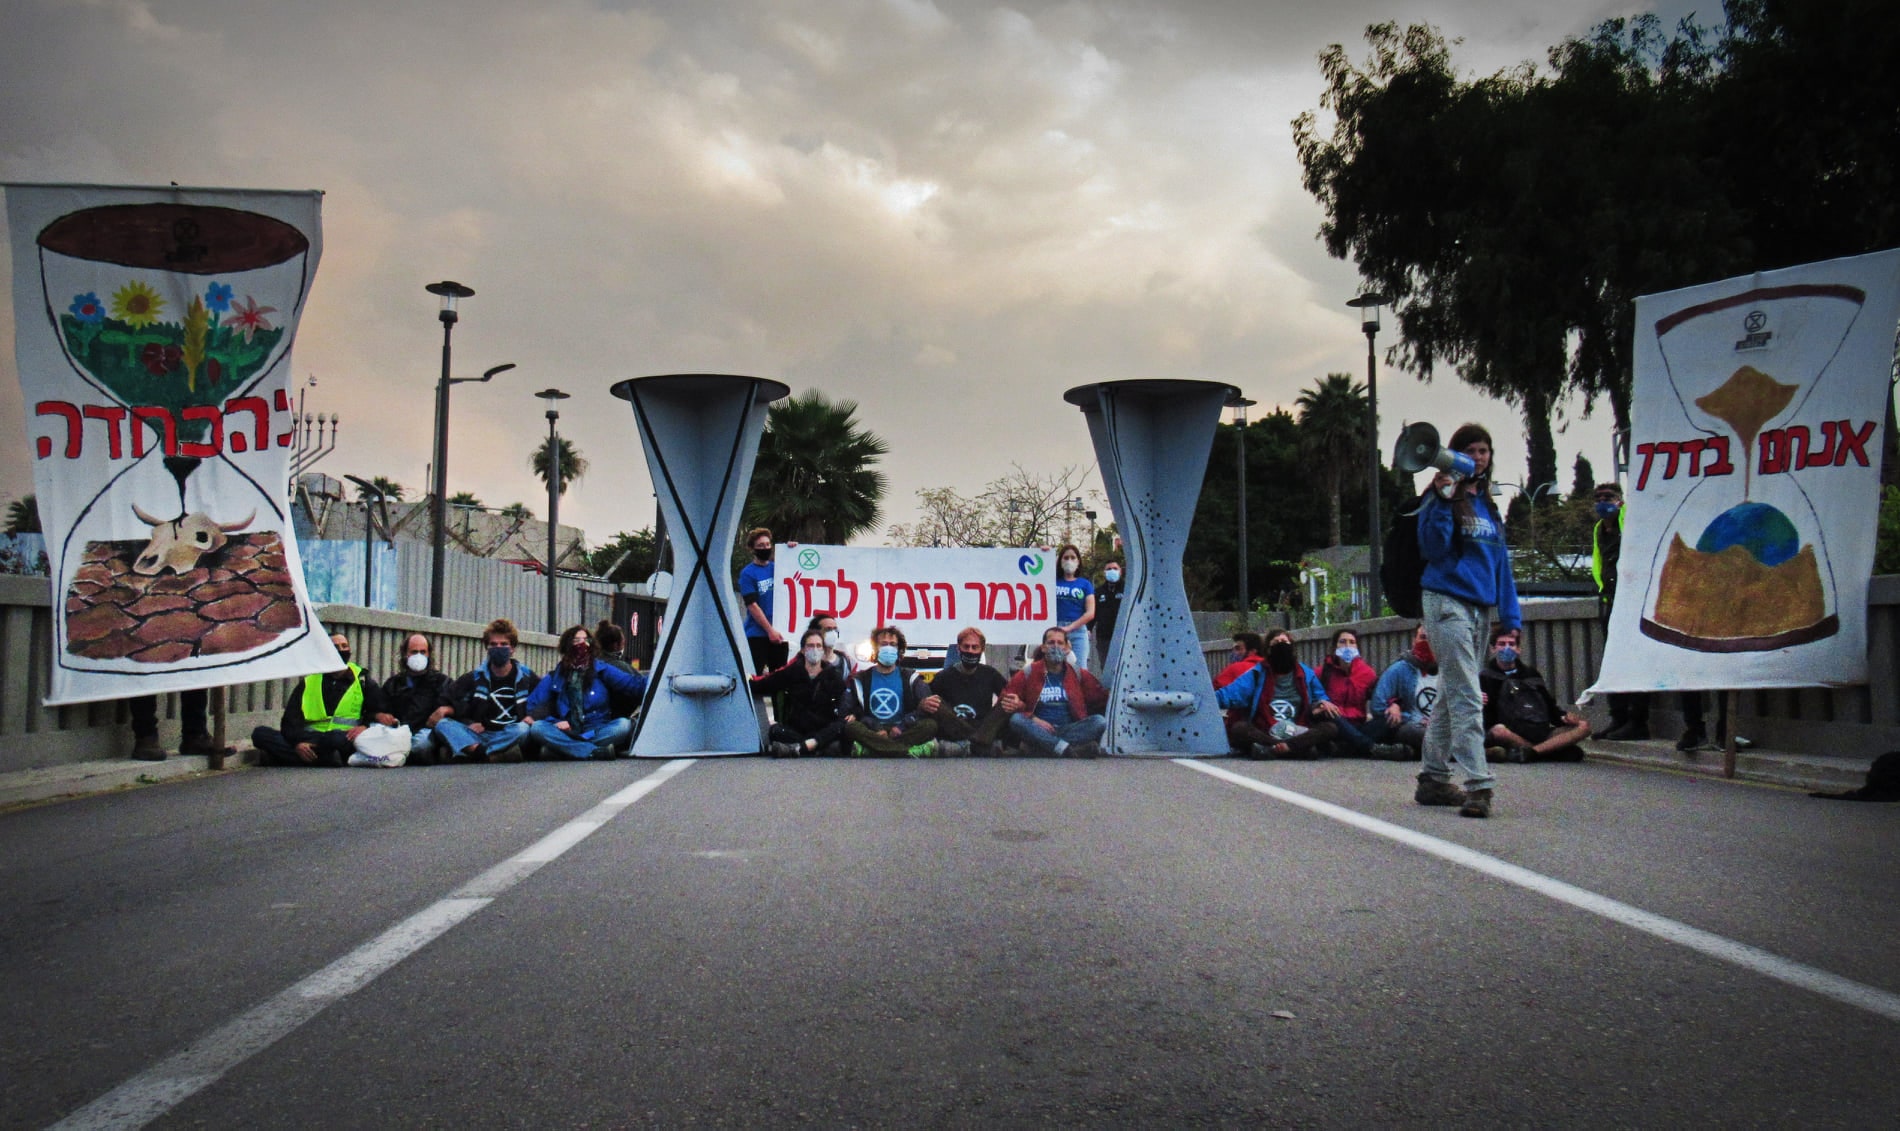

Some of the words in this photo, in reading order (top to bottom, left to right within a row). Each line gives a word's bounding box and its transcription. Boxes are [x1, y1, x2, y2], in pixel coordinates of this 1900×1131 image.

[1636, 436, 1734, 491] בדרך
[783, 569, 859, 633] לבז"ן
[870, 581, 956, 629] הזמן
[964, 581, 1048, 621] נגמר
